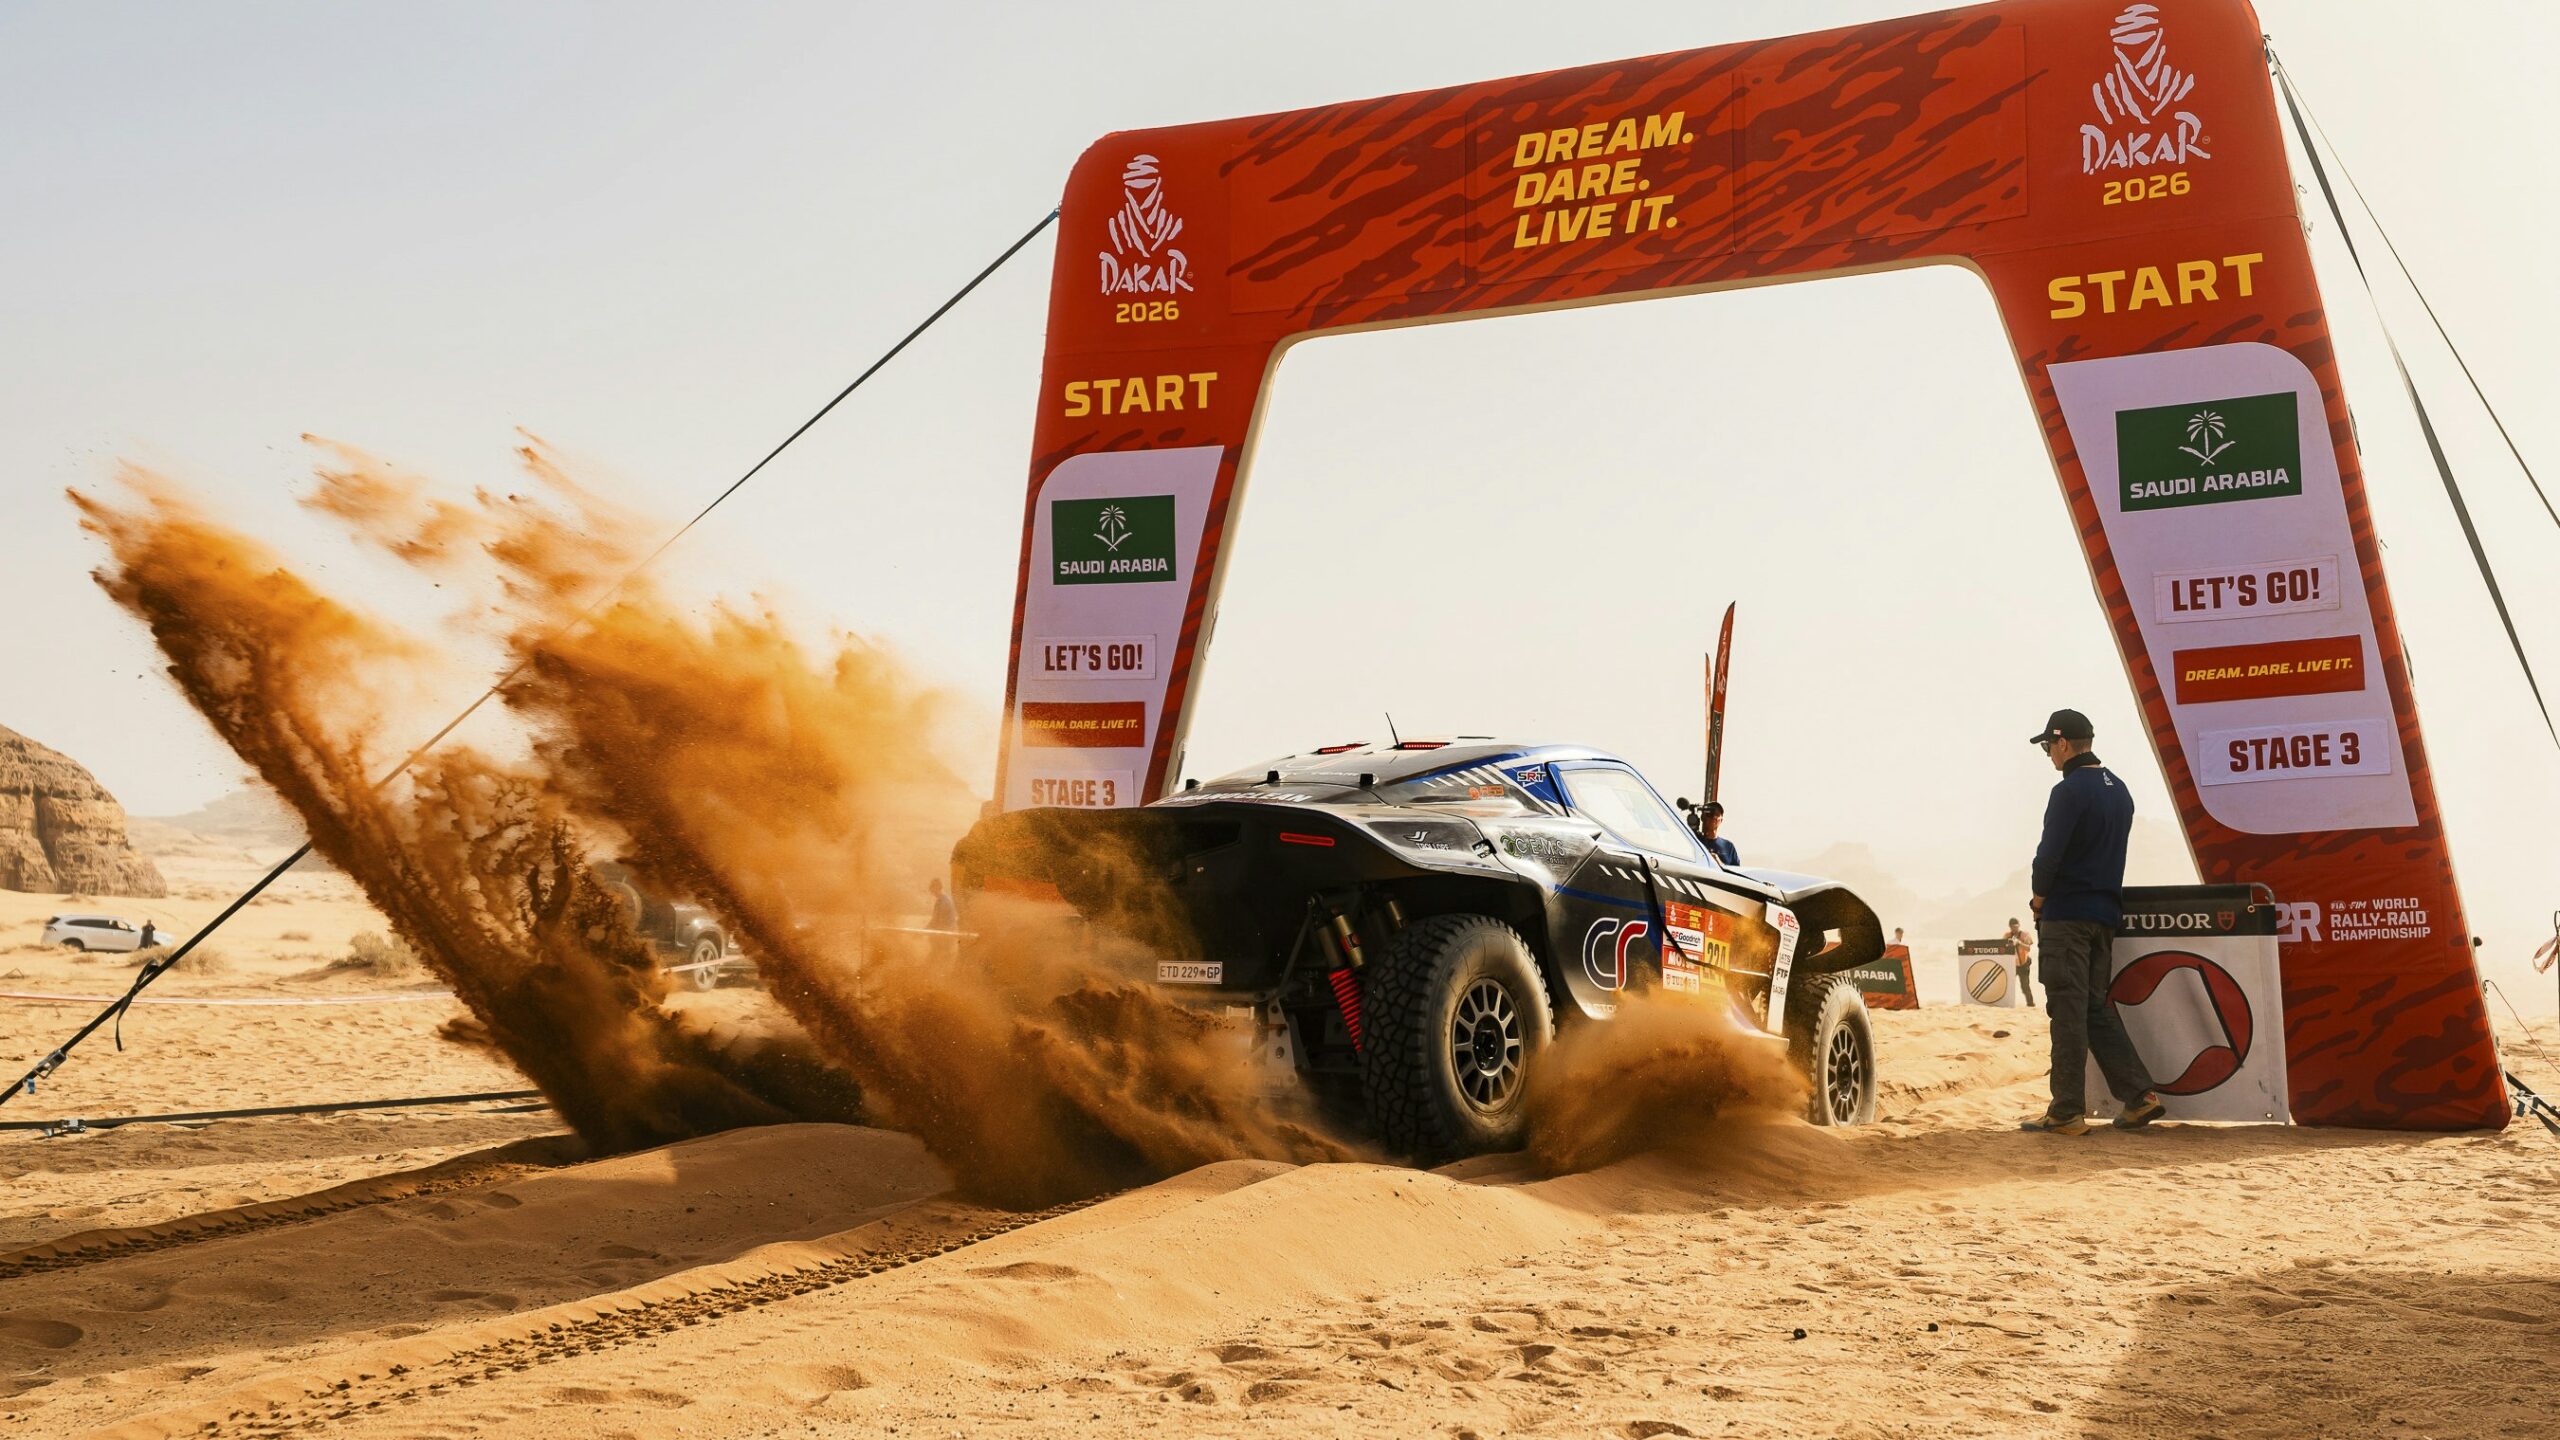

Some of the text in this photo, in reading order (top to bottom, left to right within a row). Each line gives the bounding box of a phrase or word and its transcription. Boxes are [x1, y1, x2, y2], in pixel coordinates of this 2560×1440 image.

[1513, 111, 1693, 168] DREAM.
[2080, 111, 2210, 175] DAKAR
[1513, 158, 1650, 208] DARE.
[2103, 172, 2190, 205] 2026
[1513, 195, 1678, 248] LIVE IT.
[1099, 249, 1194, 295] DAKAR
[2048, 252, 2263, 320] START
[1116, 301, 1180, 323] 2026
[1064, 372, 1218, 417] START
[2130, 467, 2289, 499] SAUDI ARABIA
[1060, 557, 1168, 575] SAUDI ARABIA
[2171, 567, 2320, 612] LET'S GO!
[1044, 644, 1143, 671] LET'S GO!
[2185, 657, 2353, 682] DREAM. DARE. LIVE IT.
[1069, 720, 1099, 729] DARE.
[1101, 720, 1124, 729] LIVE
[1126, 719, 1138, 728] IT.
[2228, 732, 2360, 773] STAGE 3
[1031, 779, 1116, 806] STAGE 3
[2331, 901, 2346, 911] FIA
[2373, 897, 2419, 911] WORLD
[2122, 913, 2212, 930] TUDOR
[2330, 911, 2427, 928] RALLY-RAID
[2331, 927, 2431, 941] CHAMPIONSHIP
[1160, 966, 1220, 978] ETD 229 GP
[1854, 970, 1897, 981] ARABIA
